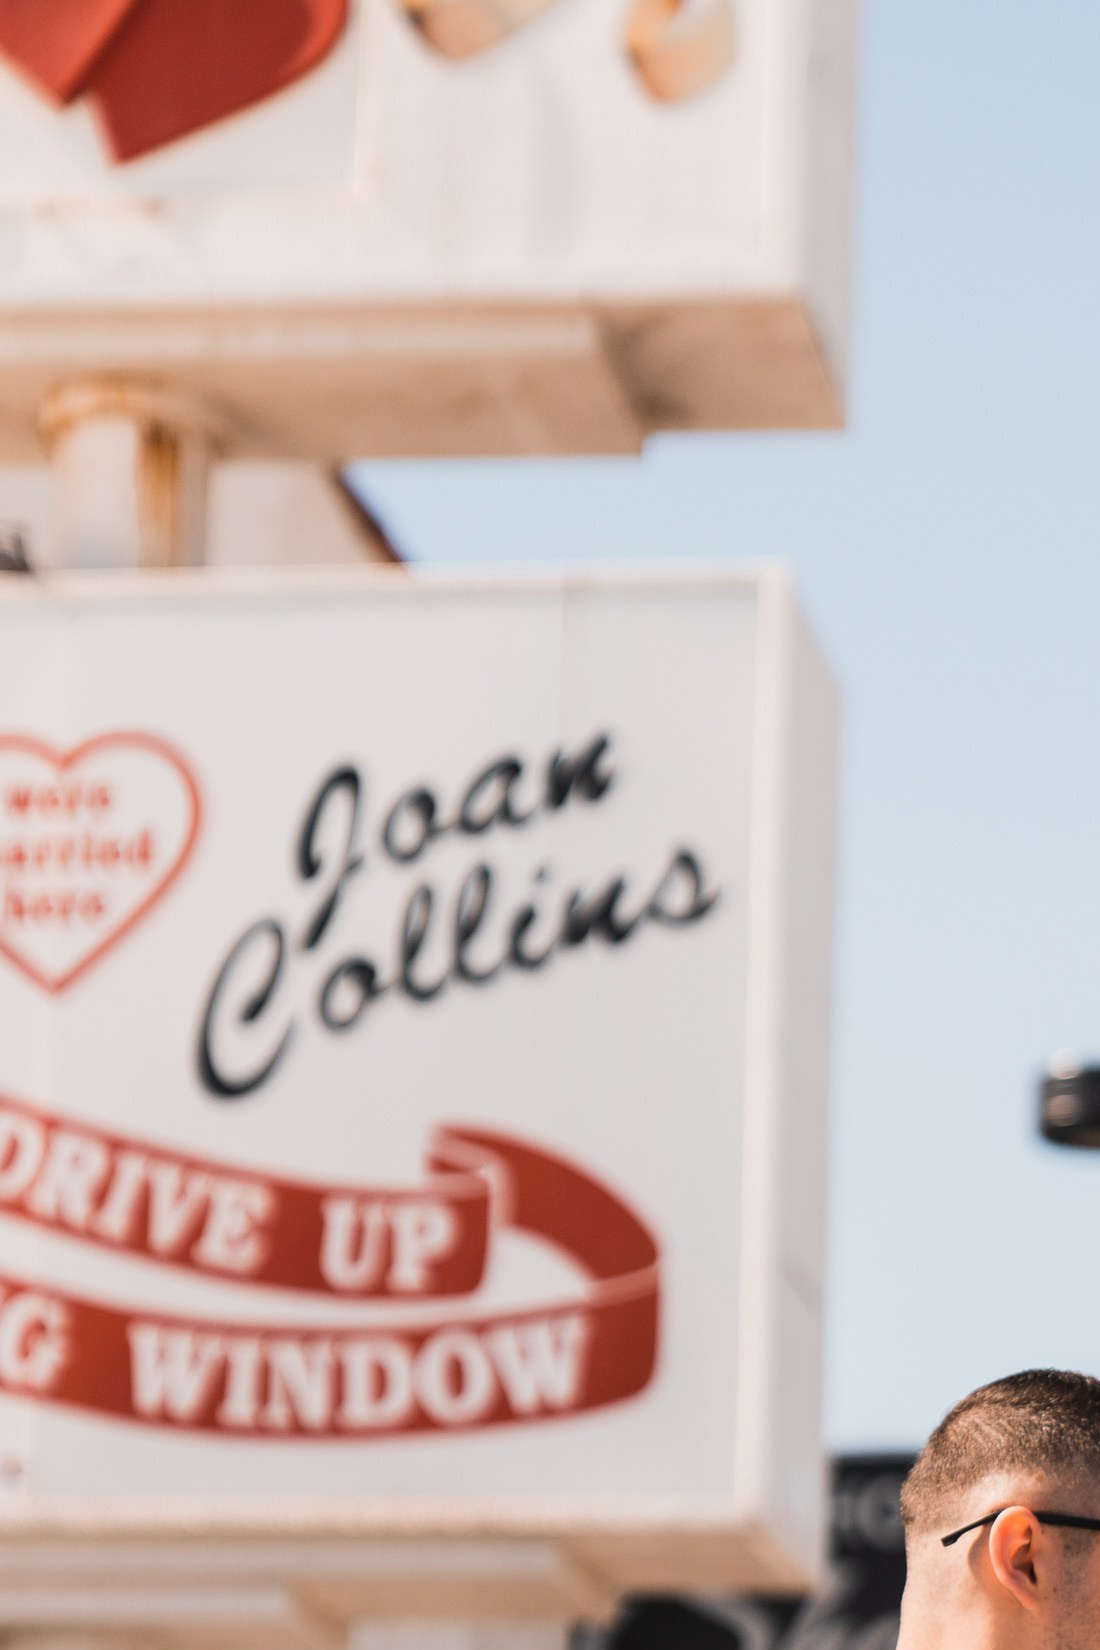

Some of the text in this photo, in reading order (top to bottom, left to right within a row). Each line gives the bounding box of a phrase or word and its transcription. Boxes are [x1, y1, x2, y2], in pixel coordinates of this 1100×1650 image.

[0, 829, 153, 870] arried
[296, 730, 616, 951] Joan
[192, 848, 722, 1101] Collins
[321, 1193, 455, 1291] UP
[127, 1308, 587, 1429] WINDOW
